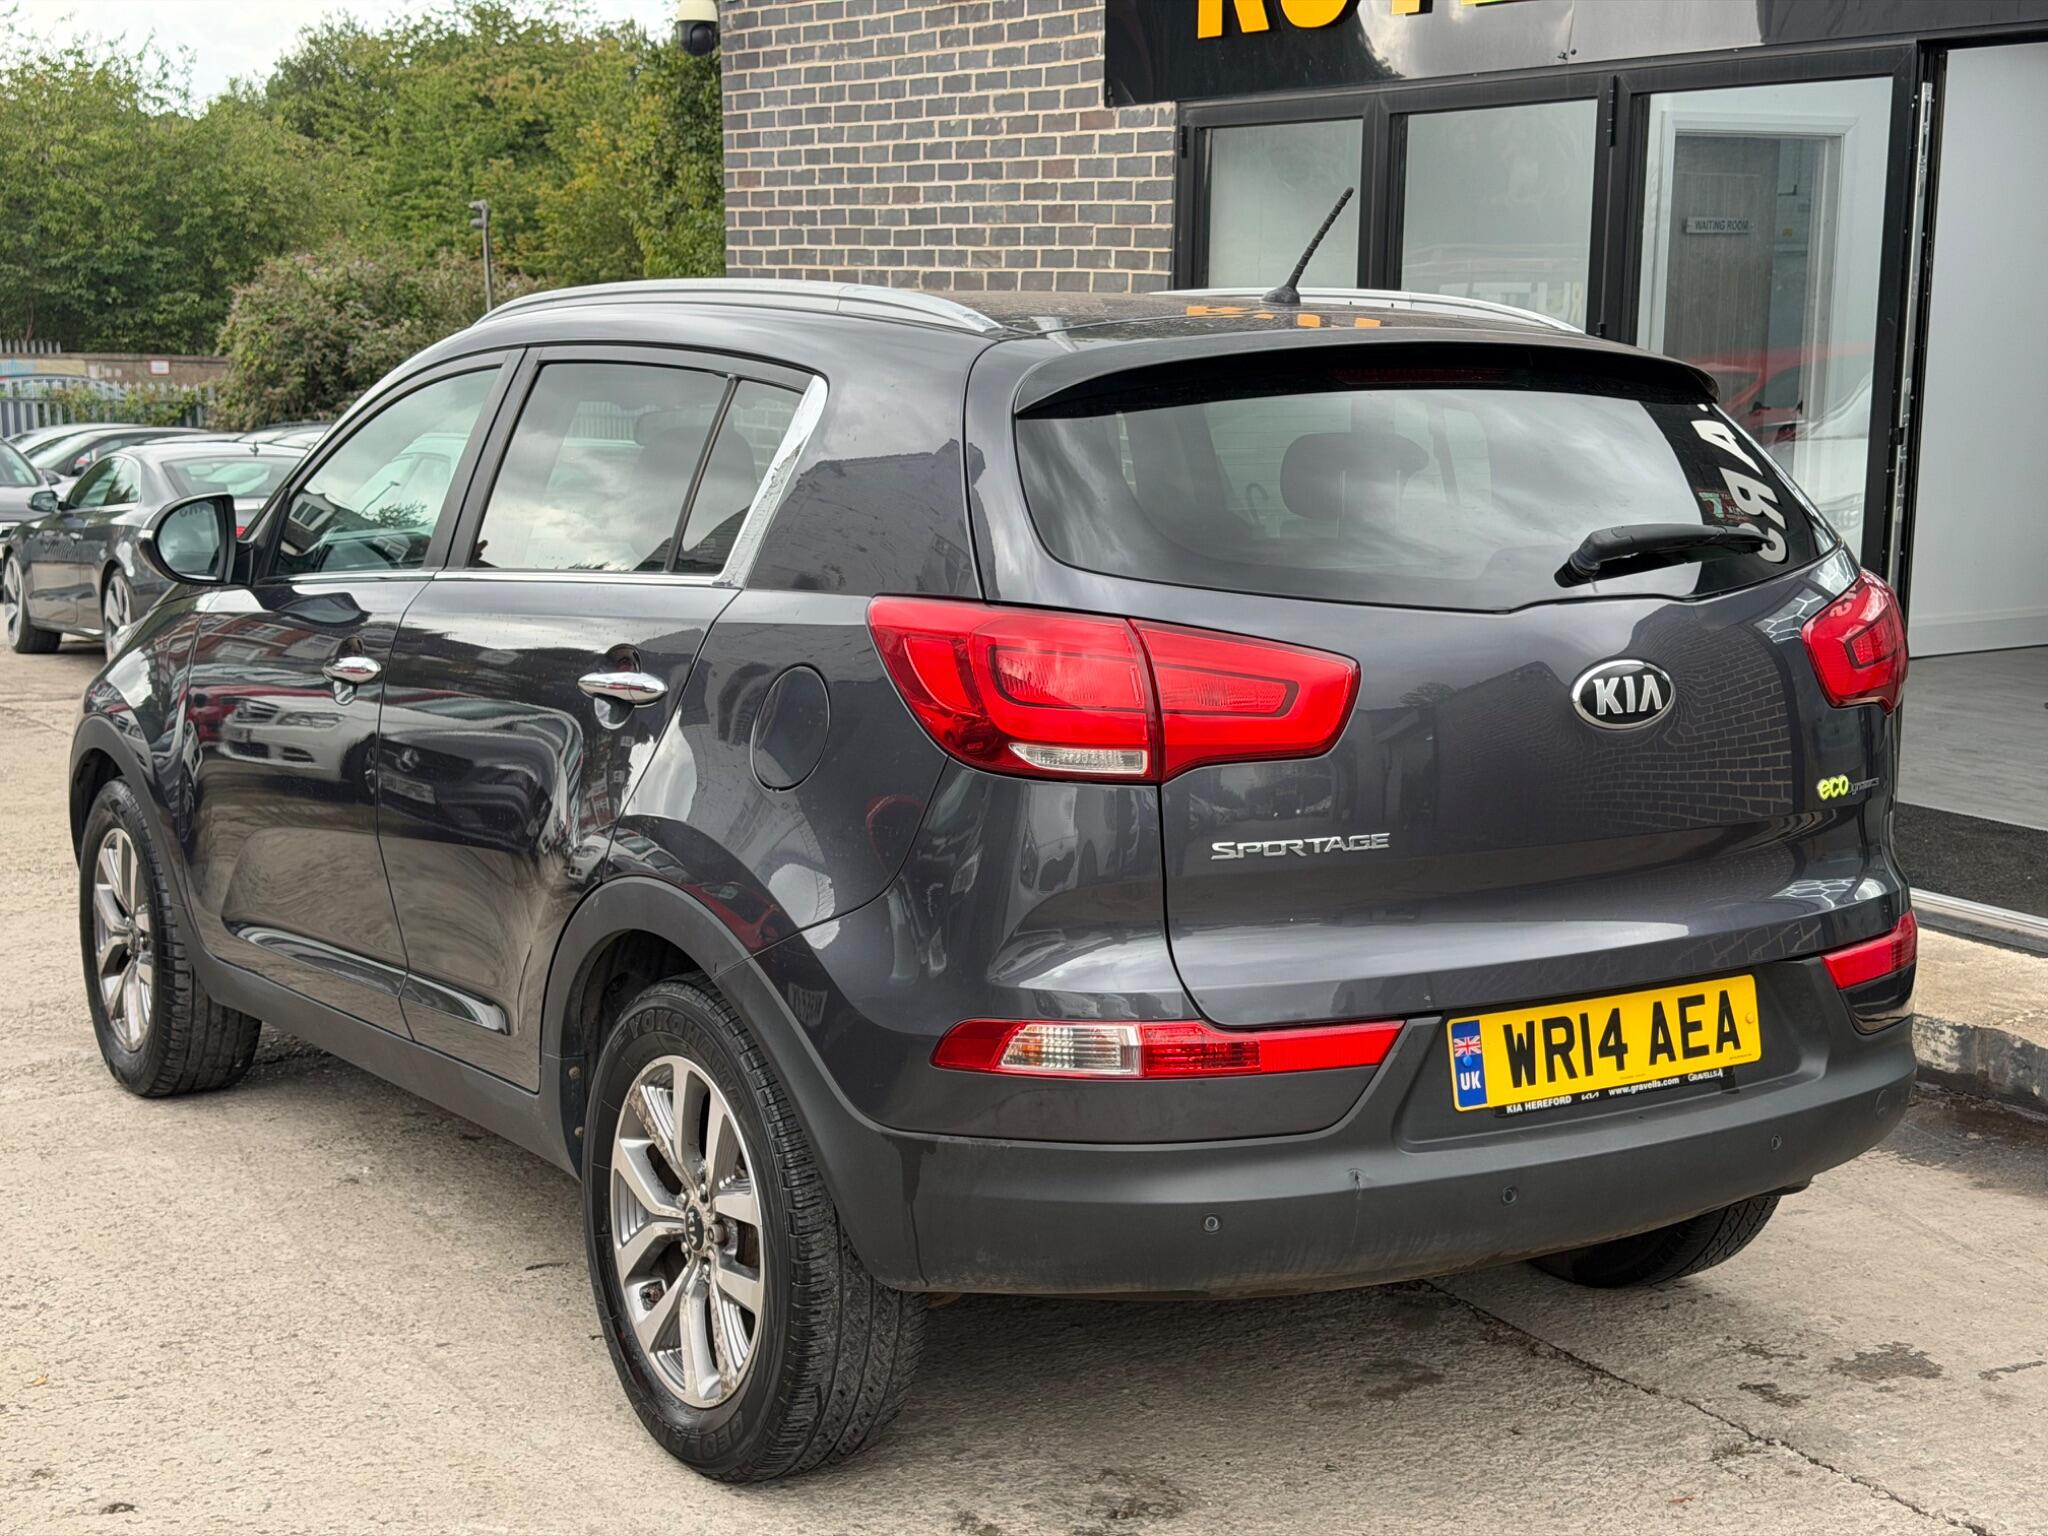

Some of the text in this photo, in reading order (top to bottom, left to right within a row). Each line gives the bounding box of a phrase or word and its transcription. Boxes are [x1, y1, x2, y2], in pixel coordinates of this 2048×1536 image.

[1695, 219, 1749, 231] WAITING ROOM
[1592, 676, 1663, 716] KIA
[1211, 833, 1391, 860] SPORTAGE
[1503, 990, 1741, 1088] WR14 AEA
[1460, 1070, 1482, 1091] UK
[1506, 1104, 1523, 1114] KIA
[1524, 1095, 1572, 1111] HEREFORD
